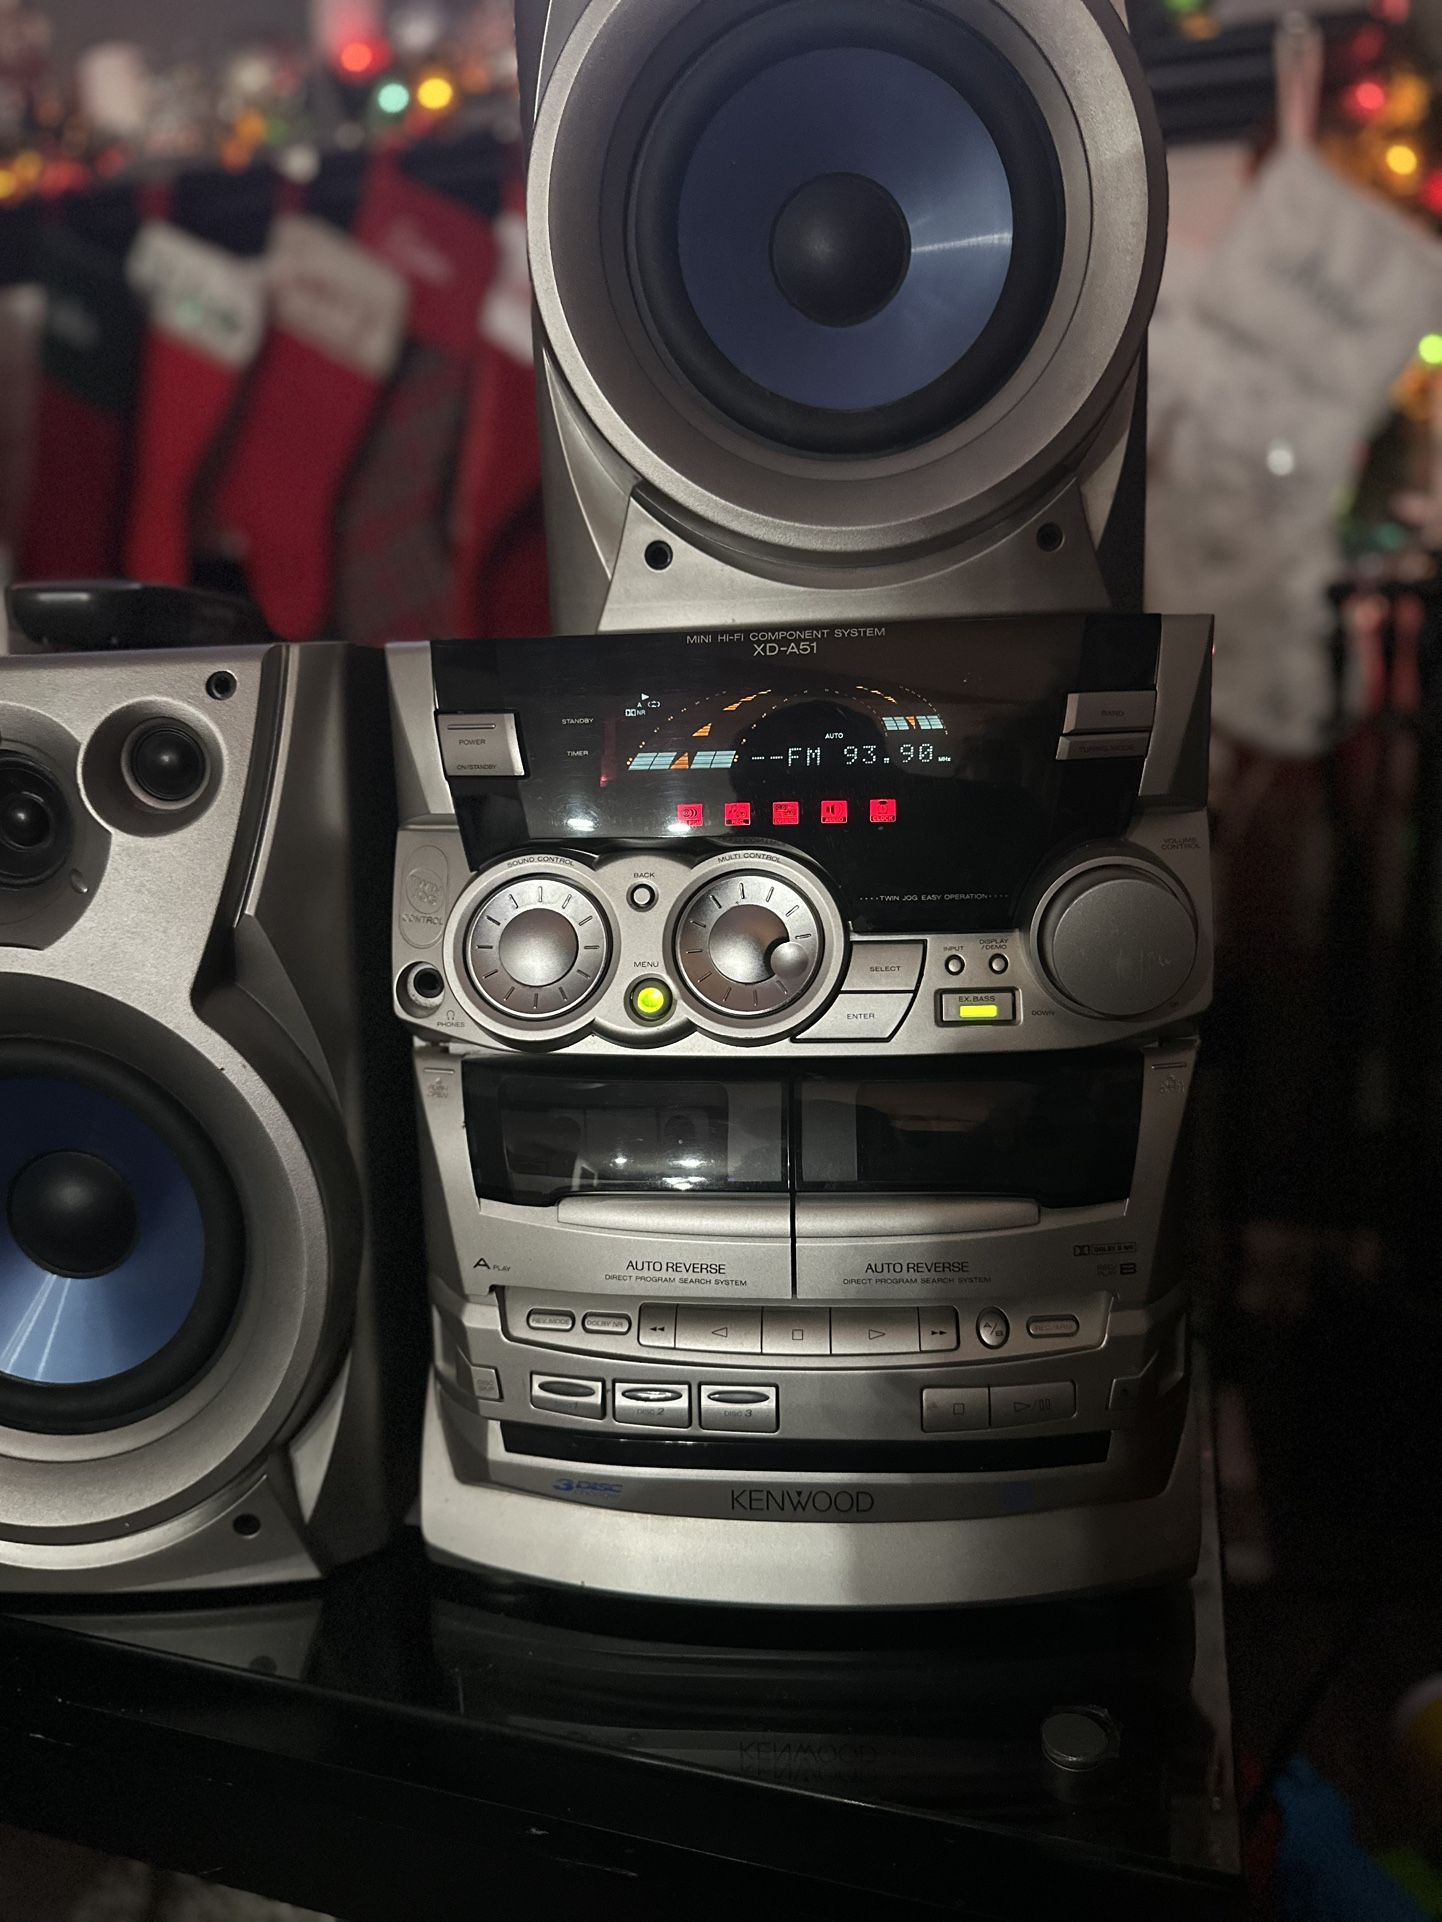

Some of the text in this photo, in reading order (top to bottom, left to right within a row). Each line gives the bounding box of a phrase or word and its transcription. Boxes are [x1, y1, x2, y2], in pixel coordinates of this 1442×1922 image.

[686, 627, 886, 644] MINI HI-FI COMPONENT SYSTEM
[753, 642, 818, 657] XD-A51
[561, 717, 594, 725] STANDBY
[458, 738, 486, 746] POWER
[824, 732, 844, 740] AUTO
[843, 742, 933, 766] 93.90
[456, 763, 497, 771] ON/STANDBY
[507, 855, 575, 868] SOUND CONTROL
[717, 852, 782, 864] MULTI CONTROL
[879, 894, 900, 902] TWIN
[902, 894, 918, 902] JOG
[944, 893, 988, 901] OPERATION
[846, 1012, 875, 1020] ENTER
[473, 1257, 491, 1270] A
[626, 1260, 726, 1275] AUTO REVERSE
[865, 1261, 969, 1274] AUTO REVERSE
[604, 1274, 747, 1287] DIRECT PROGRAM SEARCH SYSTEM
[875, 1277, 918, 1285] PROGRAM
[920, 1276, 955, 1284] SEARCH
[957, 1275, 992, 1284] SYSTEM
[656, 1407, 665, 1416] 2
[744, 1408, 753, 1417] 3
[730, 1489, 874, 1513] KENWOOD
